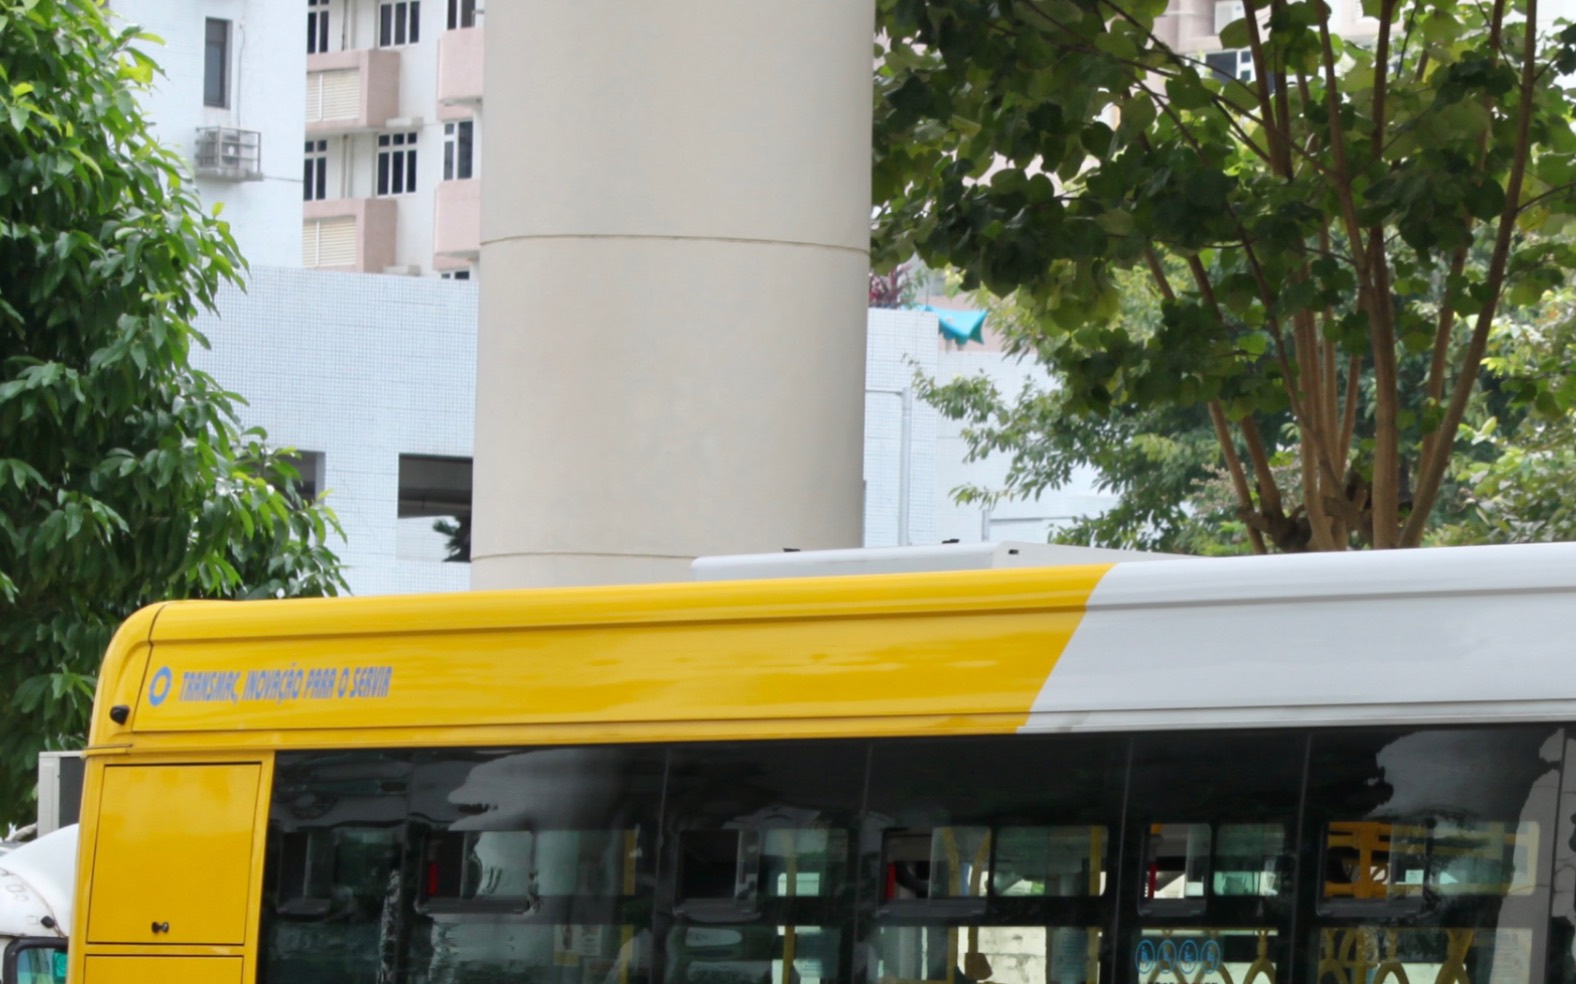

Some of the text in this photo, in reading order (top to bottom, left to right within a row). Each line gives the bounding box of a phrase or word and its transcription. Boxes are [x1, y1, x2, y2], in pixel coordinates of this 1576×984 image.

[303, 667, 338, 699] PARA
[338, 667, 349, 698] O
[349, 665, 393, 698] SERVIR
